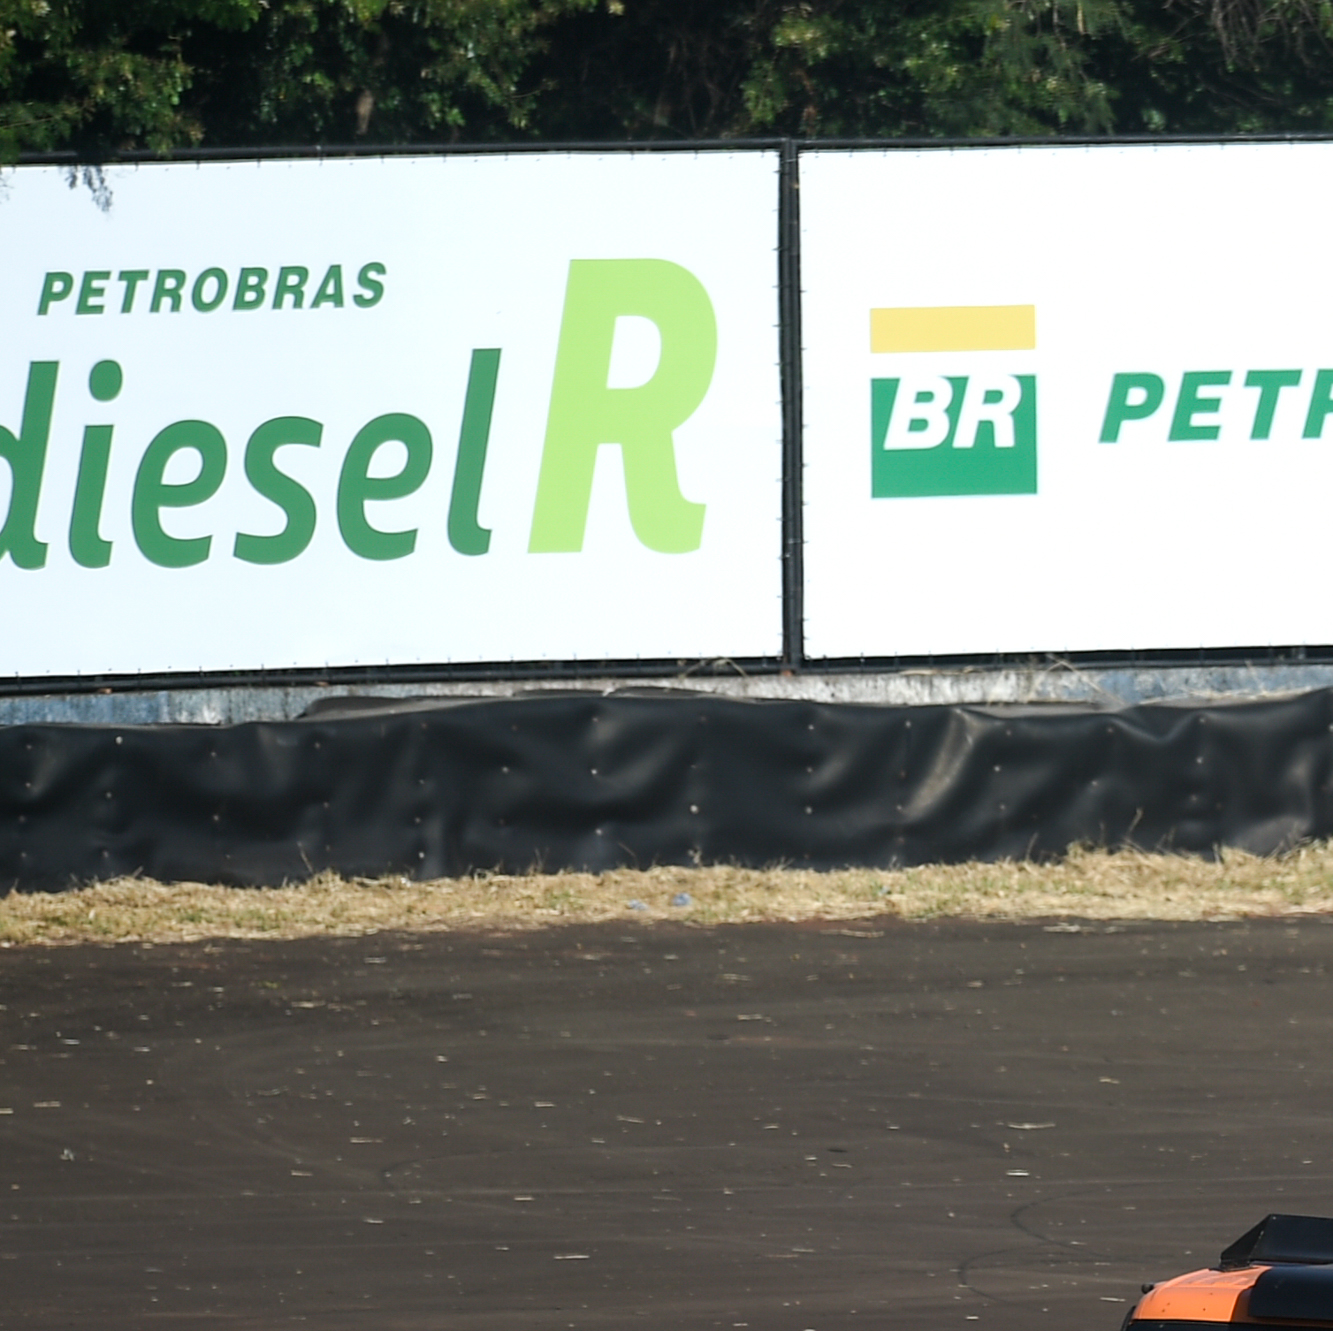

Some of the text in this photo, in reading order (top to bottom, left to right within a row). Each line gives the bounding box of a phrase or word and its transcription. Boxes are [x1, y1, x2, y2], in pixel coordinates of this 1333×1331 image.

[37, 261, 388, 317] PETROBRAS
[0, 258, 718, 571] diesel R
[883, 374, 1021, 451] BR
